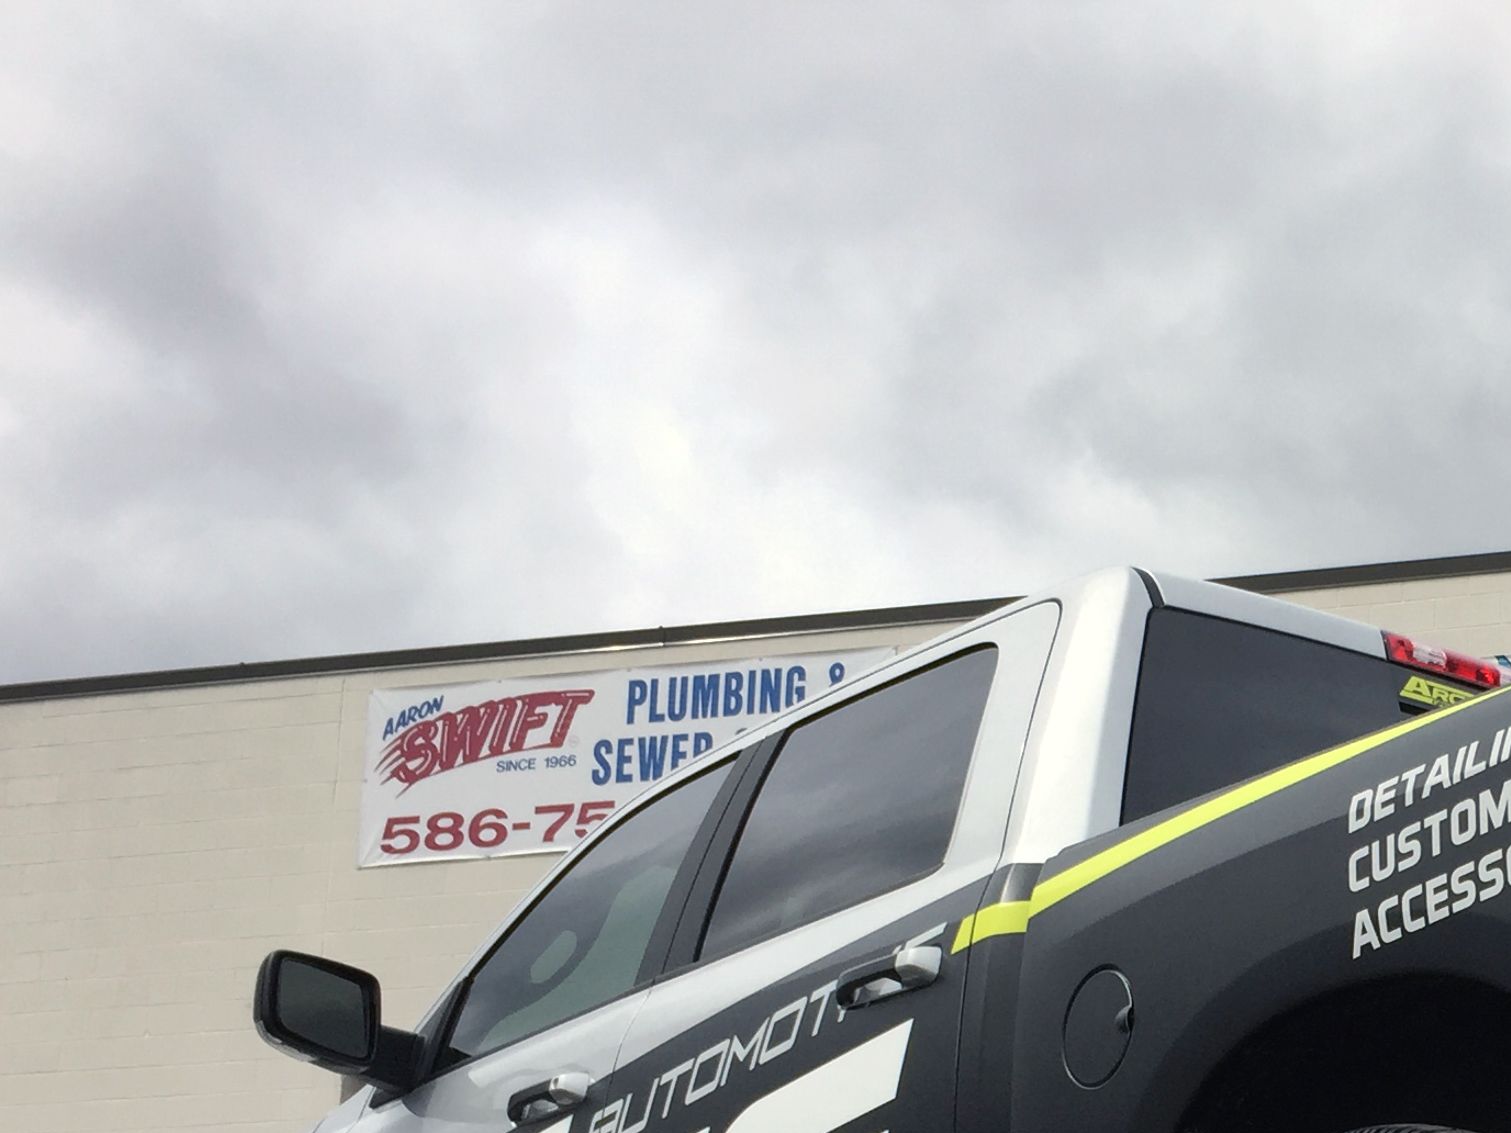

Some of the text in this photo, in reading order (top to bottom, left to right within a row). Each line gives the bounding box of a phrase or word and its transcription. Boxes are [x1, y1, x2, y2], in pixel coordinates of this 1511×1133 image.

[382, 695, 444, 741] AARON
[626, 665, 806, 725] PLUMBING
[389, 689, 595, 786] SWIFT
[496, 754, 577, 773] SINCE 1966
